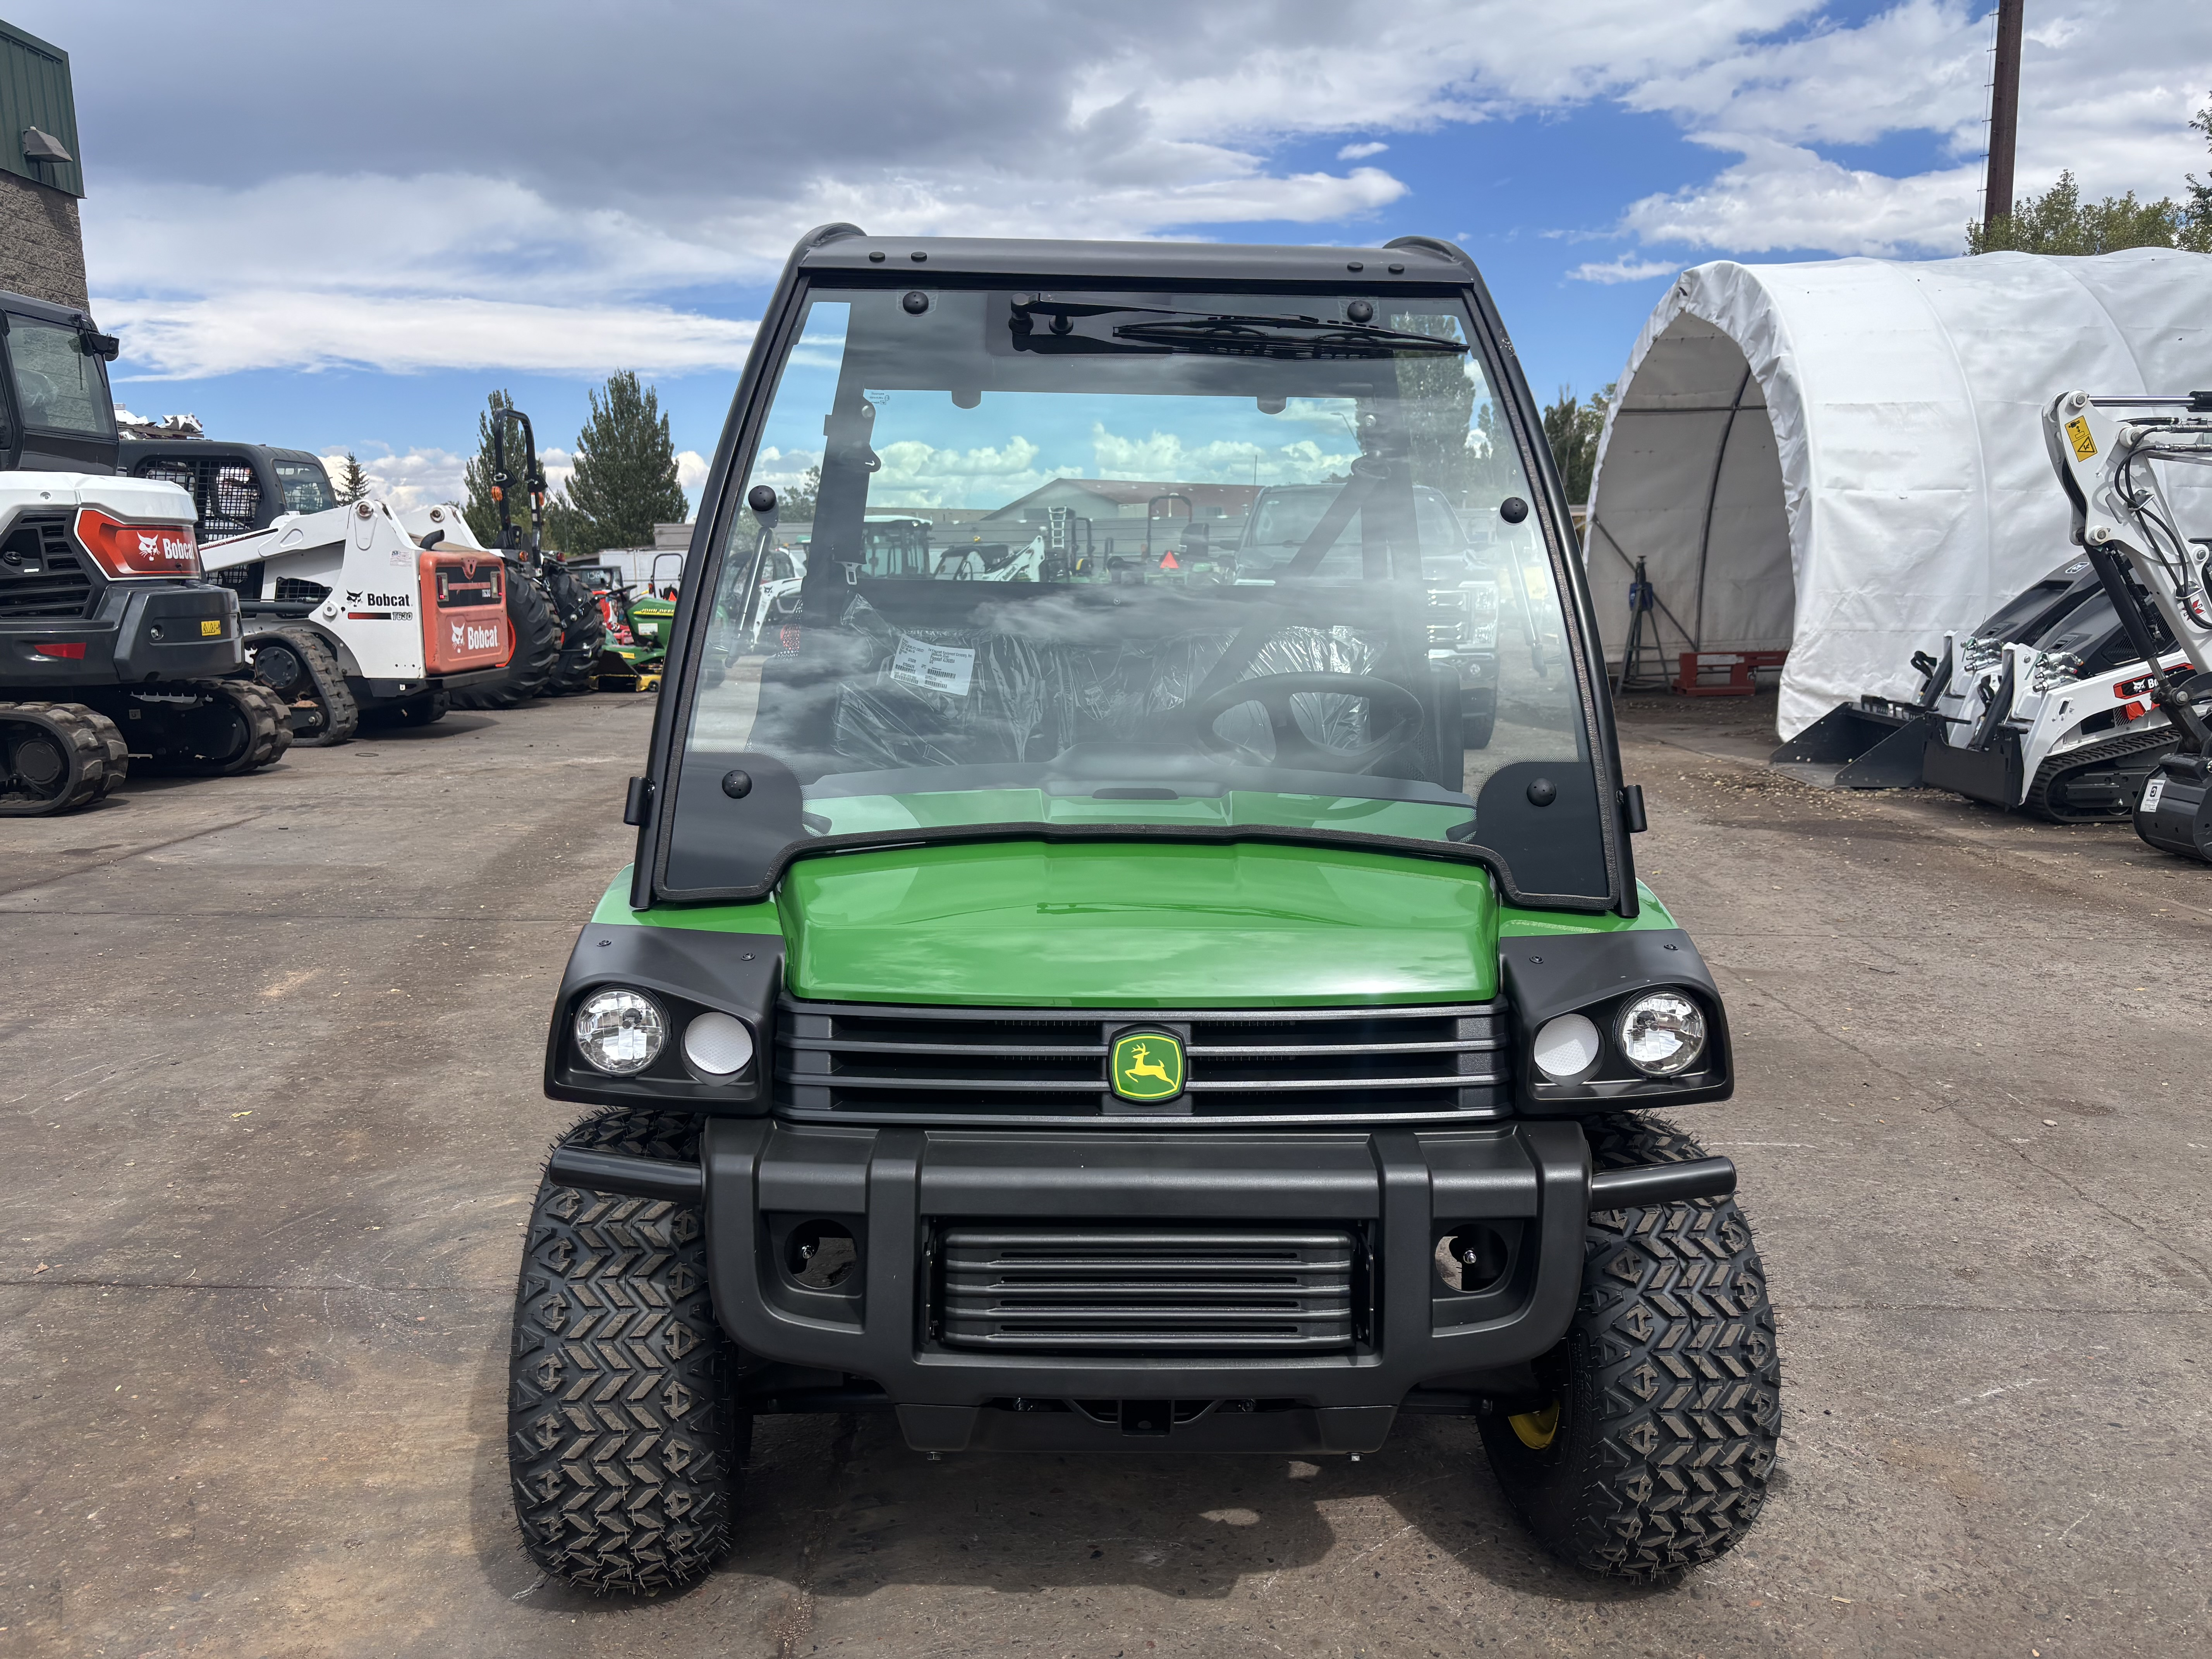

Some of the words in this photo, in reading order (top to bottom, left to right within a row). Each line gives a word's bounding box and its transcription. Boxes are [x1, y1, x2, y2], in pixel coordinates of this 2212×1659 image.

[163, 538, 195, 560] Bobcat
[368, 593, 410, 606] Bobcat
[393, 612, 413, 621] T630
[467, 625, 498, 650] Bobcat
